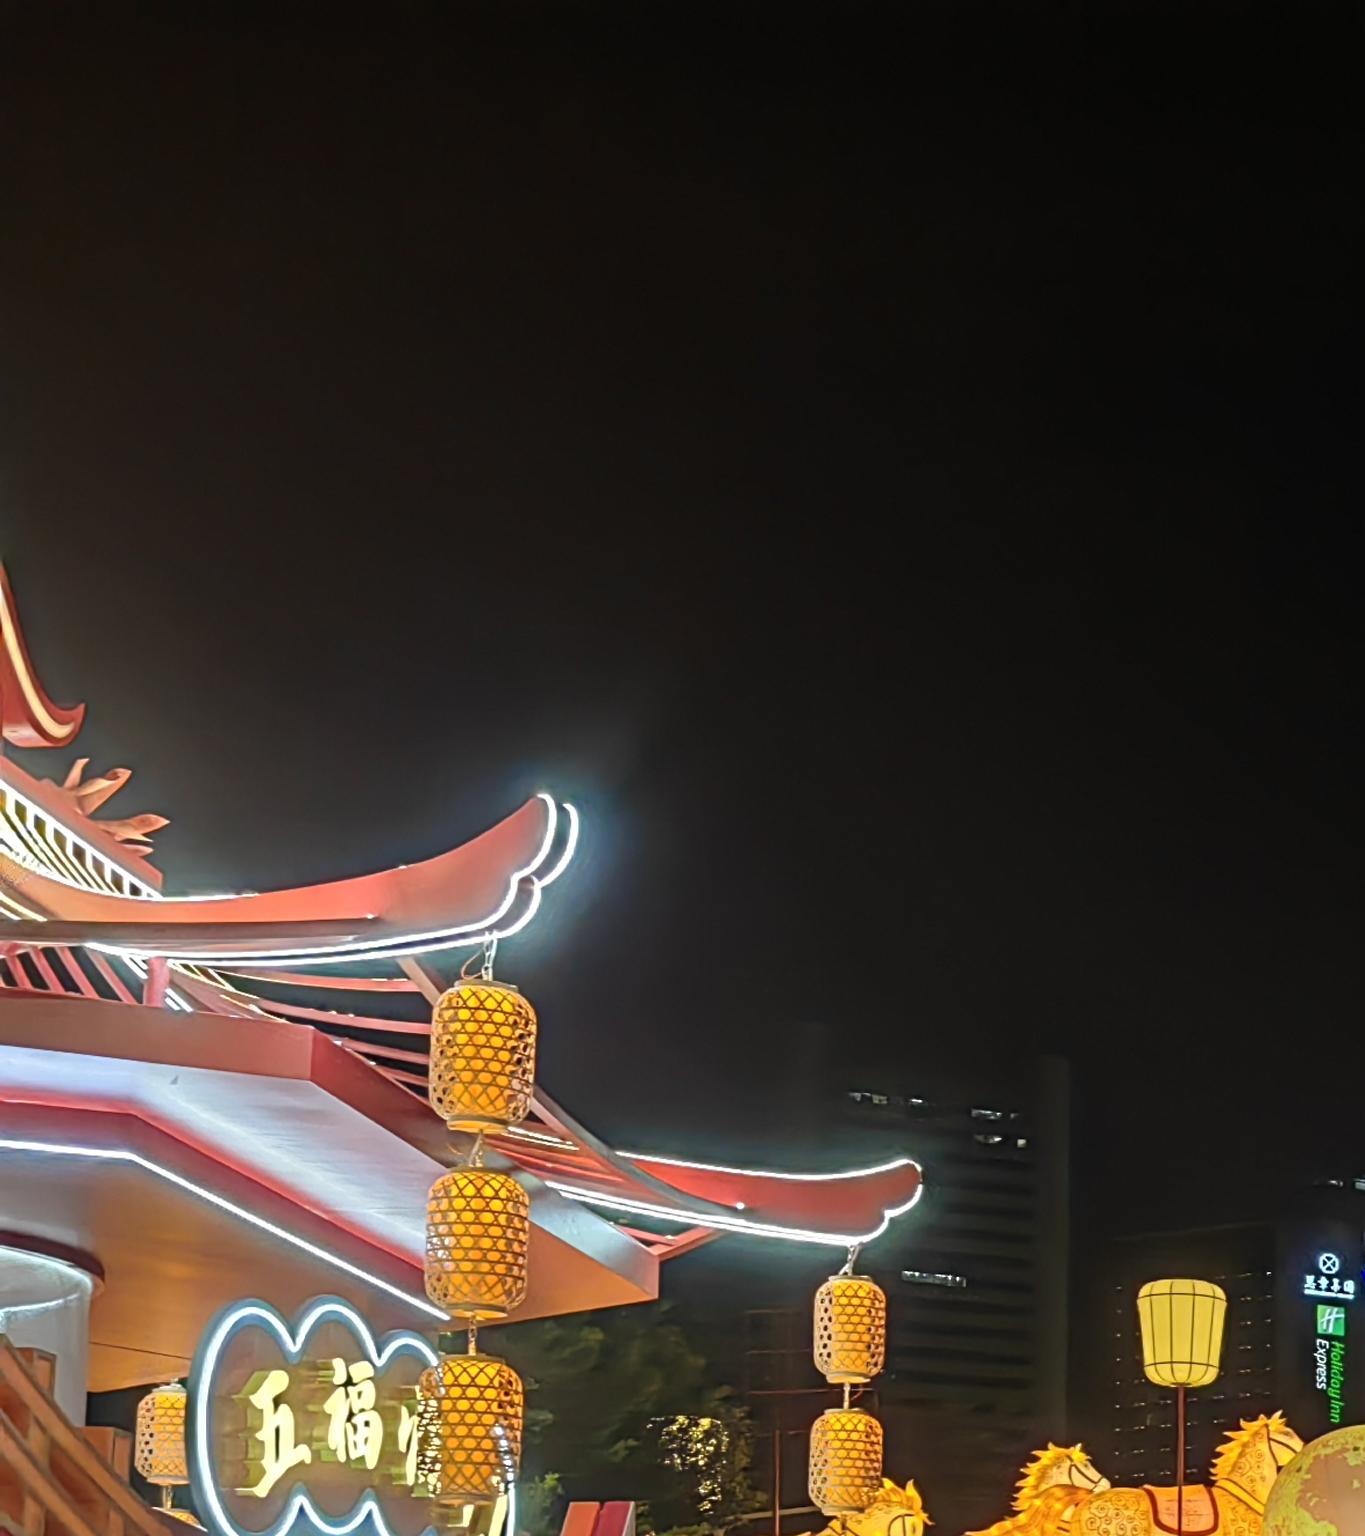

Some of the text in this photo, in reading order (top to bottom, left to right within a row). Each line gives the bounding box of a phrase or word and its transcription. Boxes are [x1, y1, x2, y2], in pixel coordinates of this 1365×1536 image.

[1313, 1338, 1329, 1390] Express
[1328, 1340, 1345, 1424] Holiday Inn
